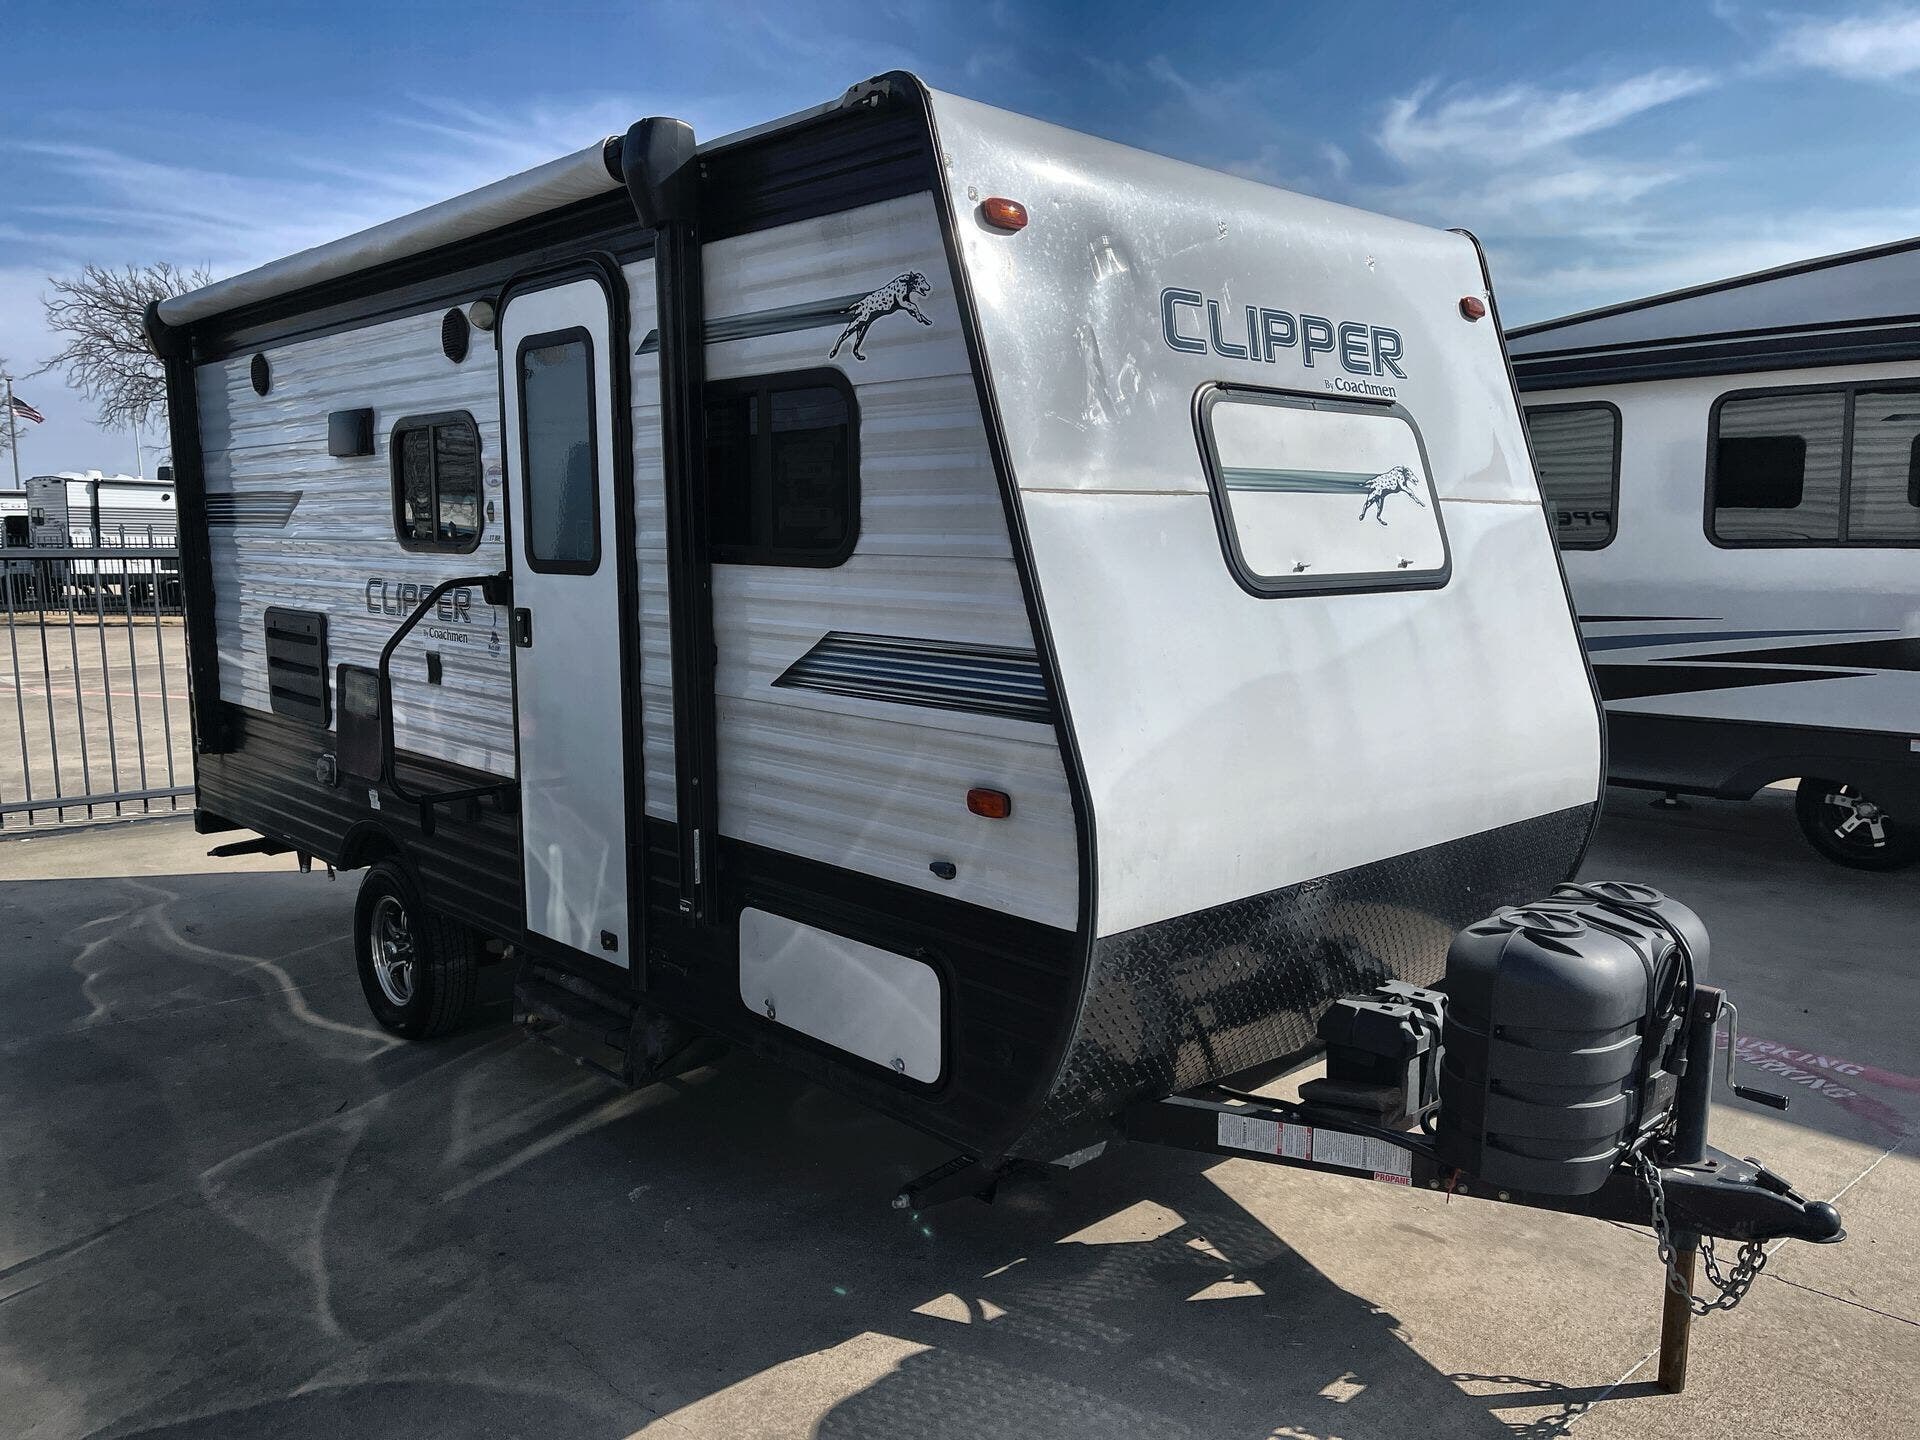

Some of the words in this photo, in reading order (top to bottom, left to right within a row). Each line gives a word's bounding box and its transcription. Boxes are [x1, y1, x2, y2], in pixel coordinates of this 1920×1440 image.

[1160, 287, 1408, 379] CLIPPER
[1324, 380, 1334, 392] By
[1335, 377, 1397, 397] Coachmen
[429, 627, 468, 643] Coachmen
[1375, 1172, 1410, 1185] PROPANE
